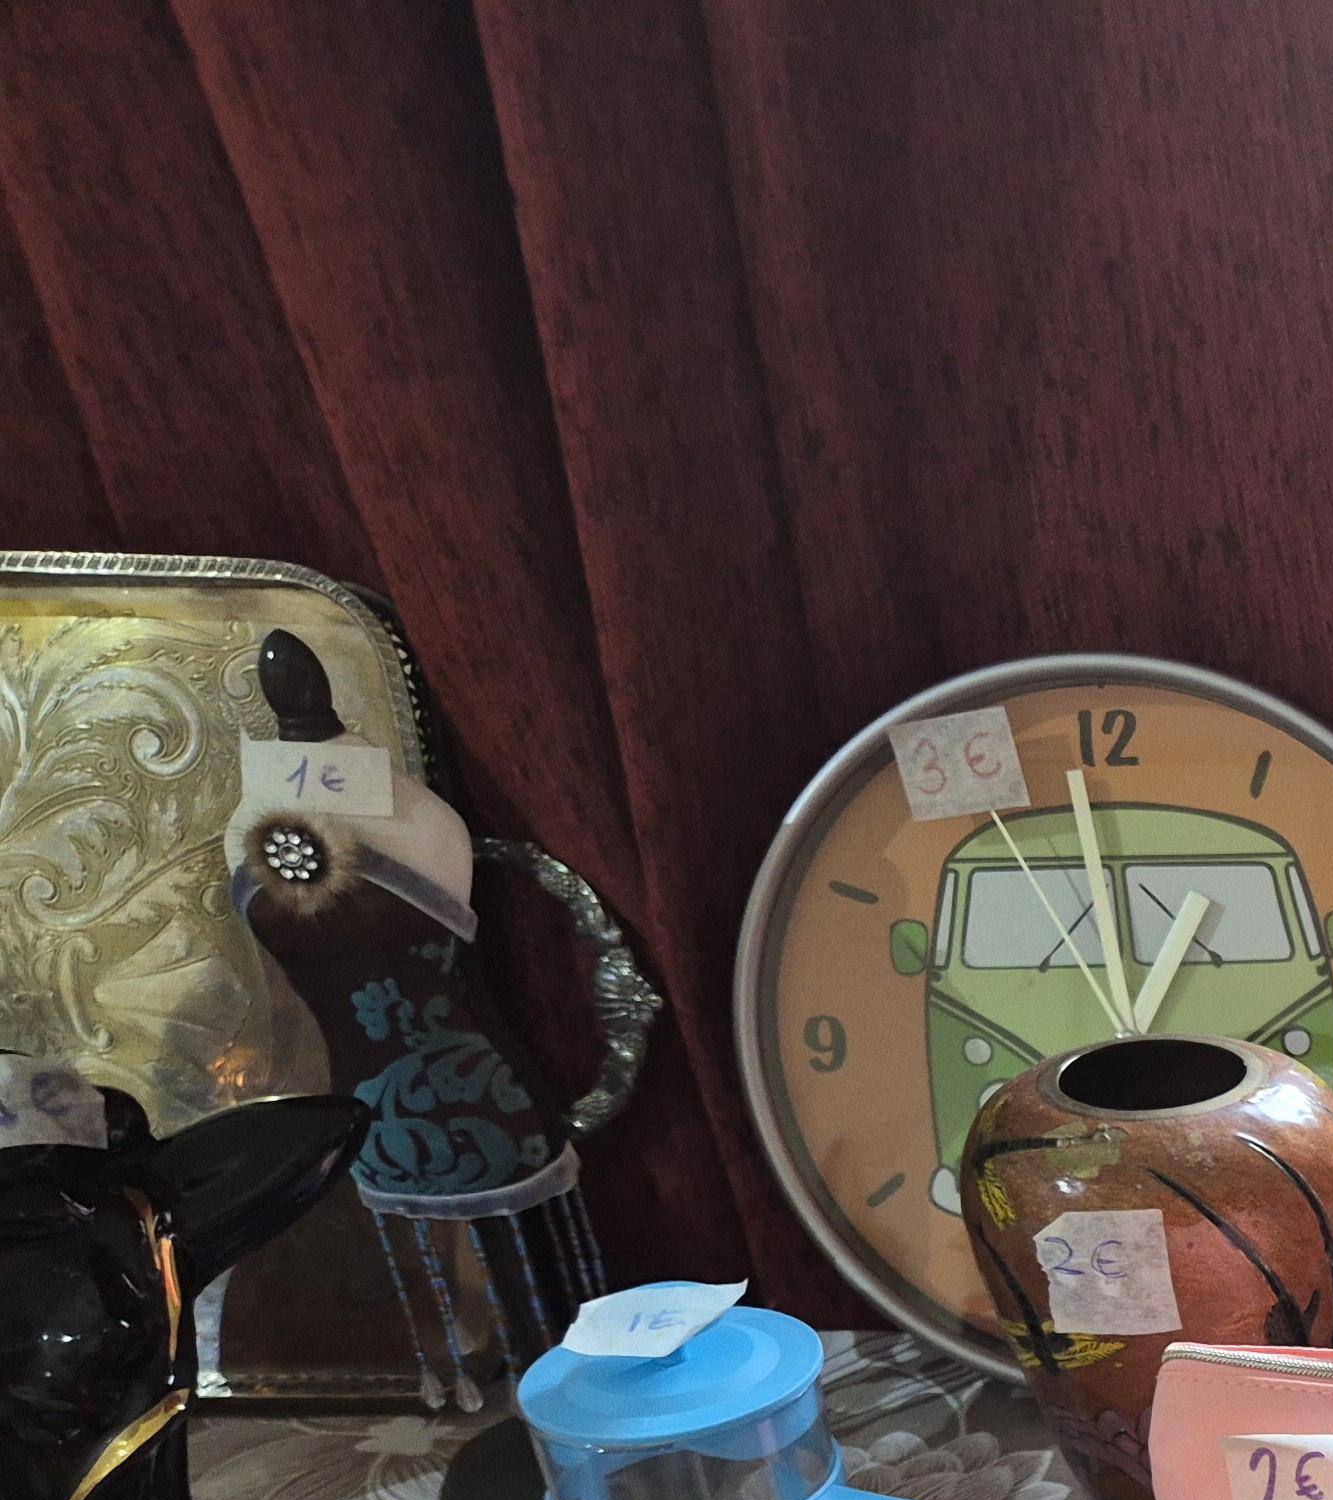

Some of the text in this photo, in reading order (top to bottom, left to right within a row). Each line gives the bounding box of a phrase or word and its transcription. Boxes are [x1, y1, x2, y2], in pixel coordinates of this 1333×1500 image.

[1075, 707, 1141, 769] 12
[285, 756, 345, 800] 1€
[803, 1014, 848, 1074] 9
[1044, 1236, 1128, 1280] 2€
